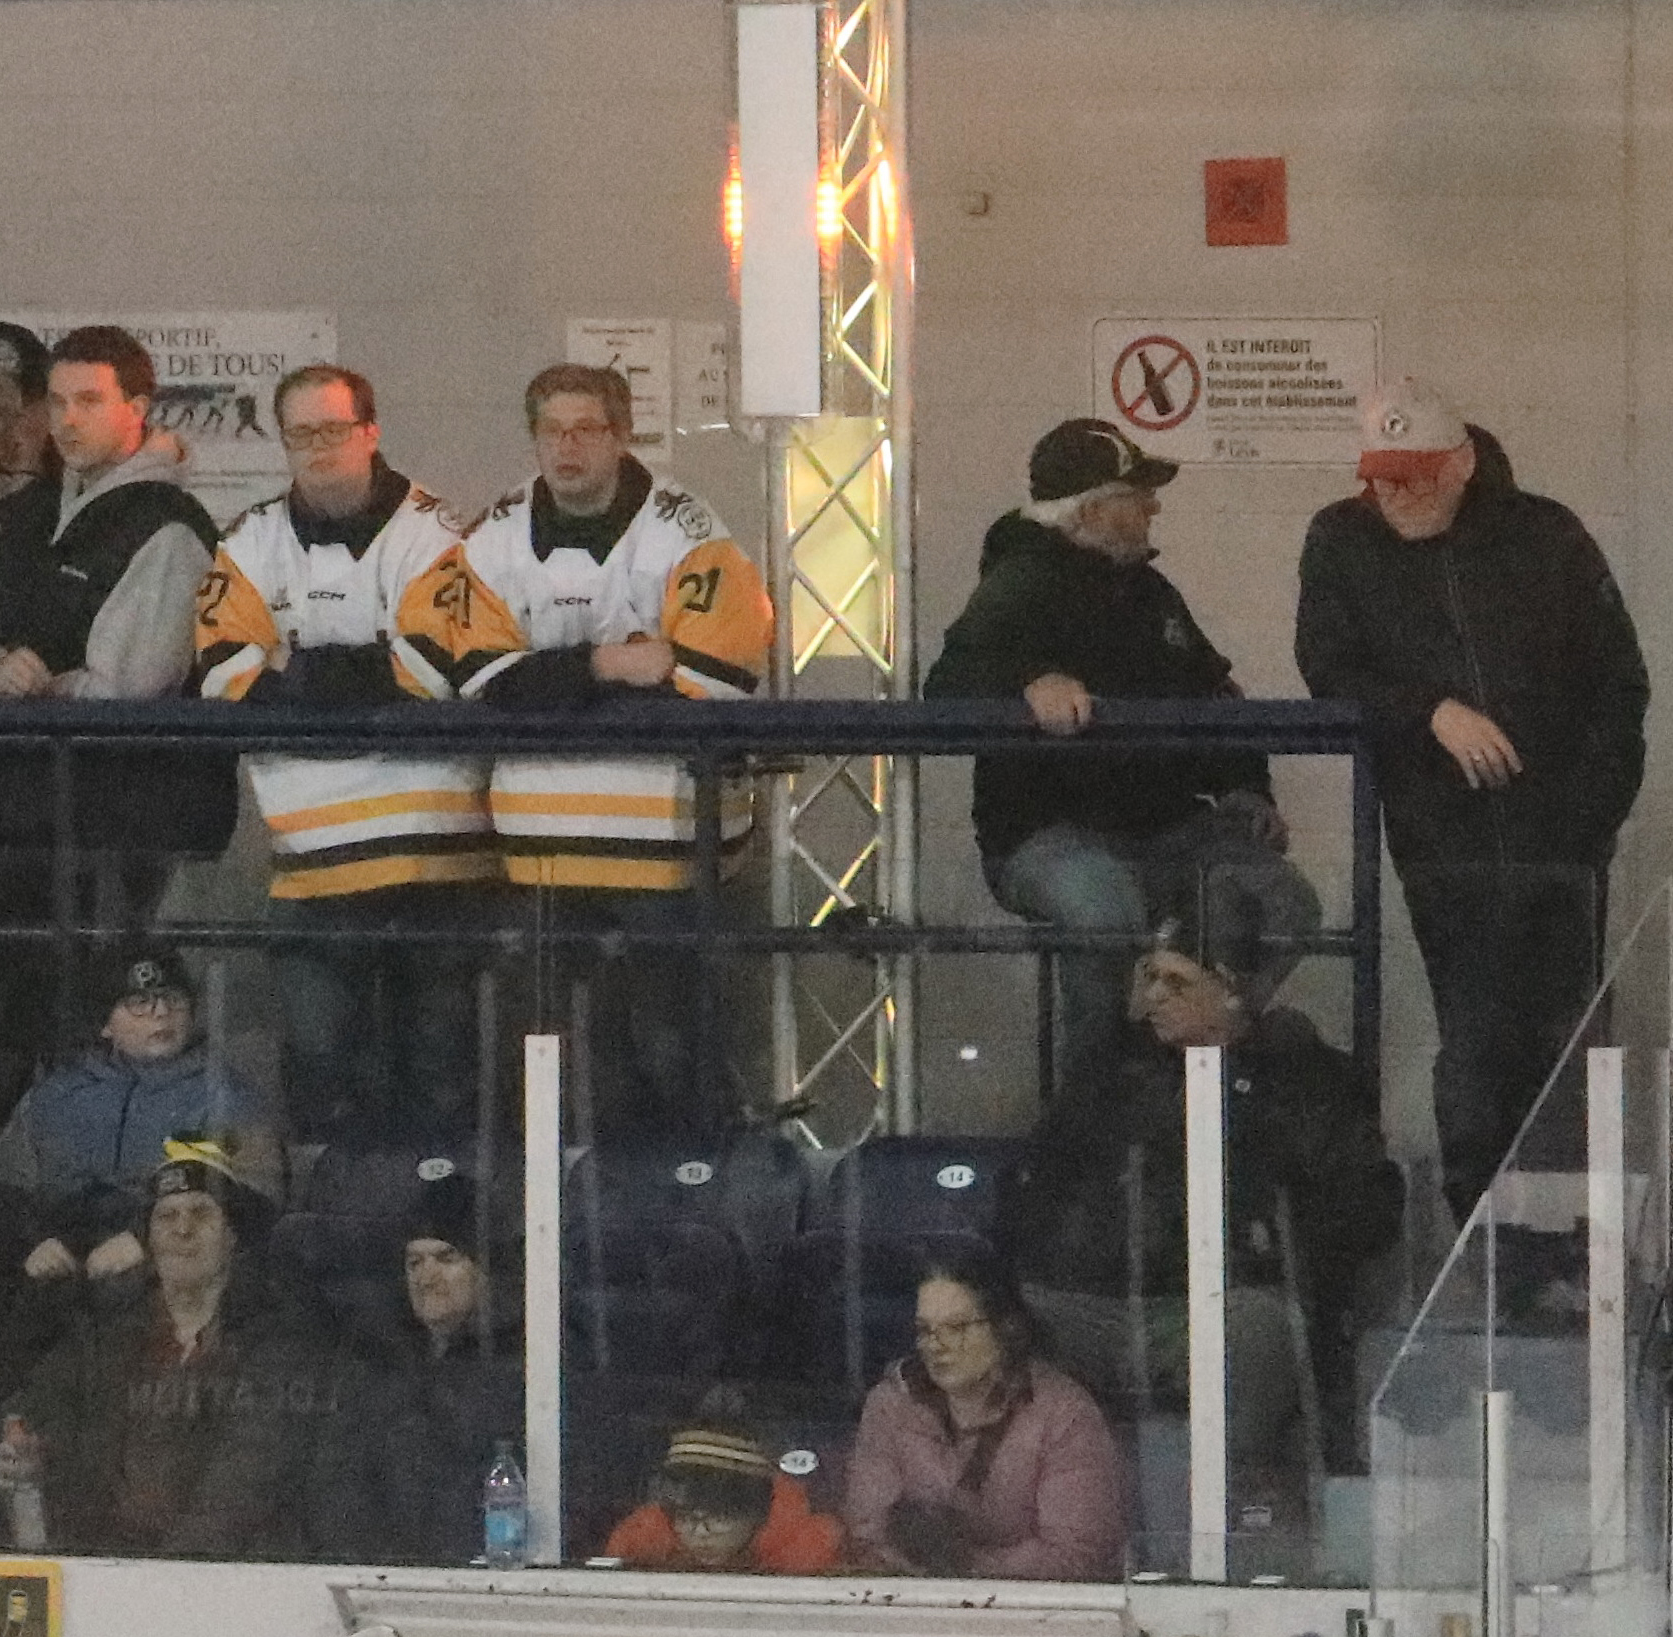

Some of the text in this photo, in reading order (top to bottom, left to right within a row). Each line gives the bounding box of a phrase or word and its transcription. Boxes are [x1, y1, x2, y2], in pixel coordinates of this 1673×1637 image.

[1221, 339, 1245, 355] EST
[1250, 339, 1312, 355] INTERDIT
[167, 353, 203, 377] DE
[208, 352, 285, 378] TOUS!
